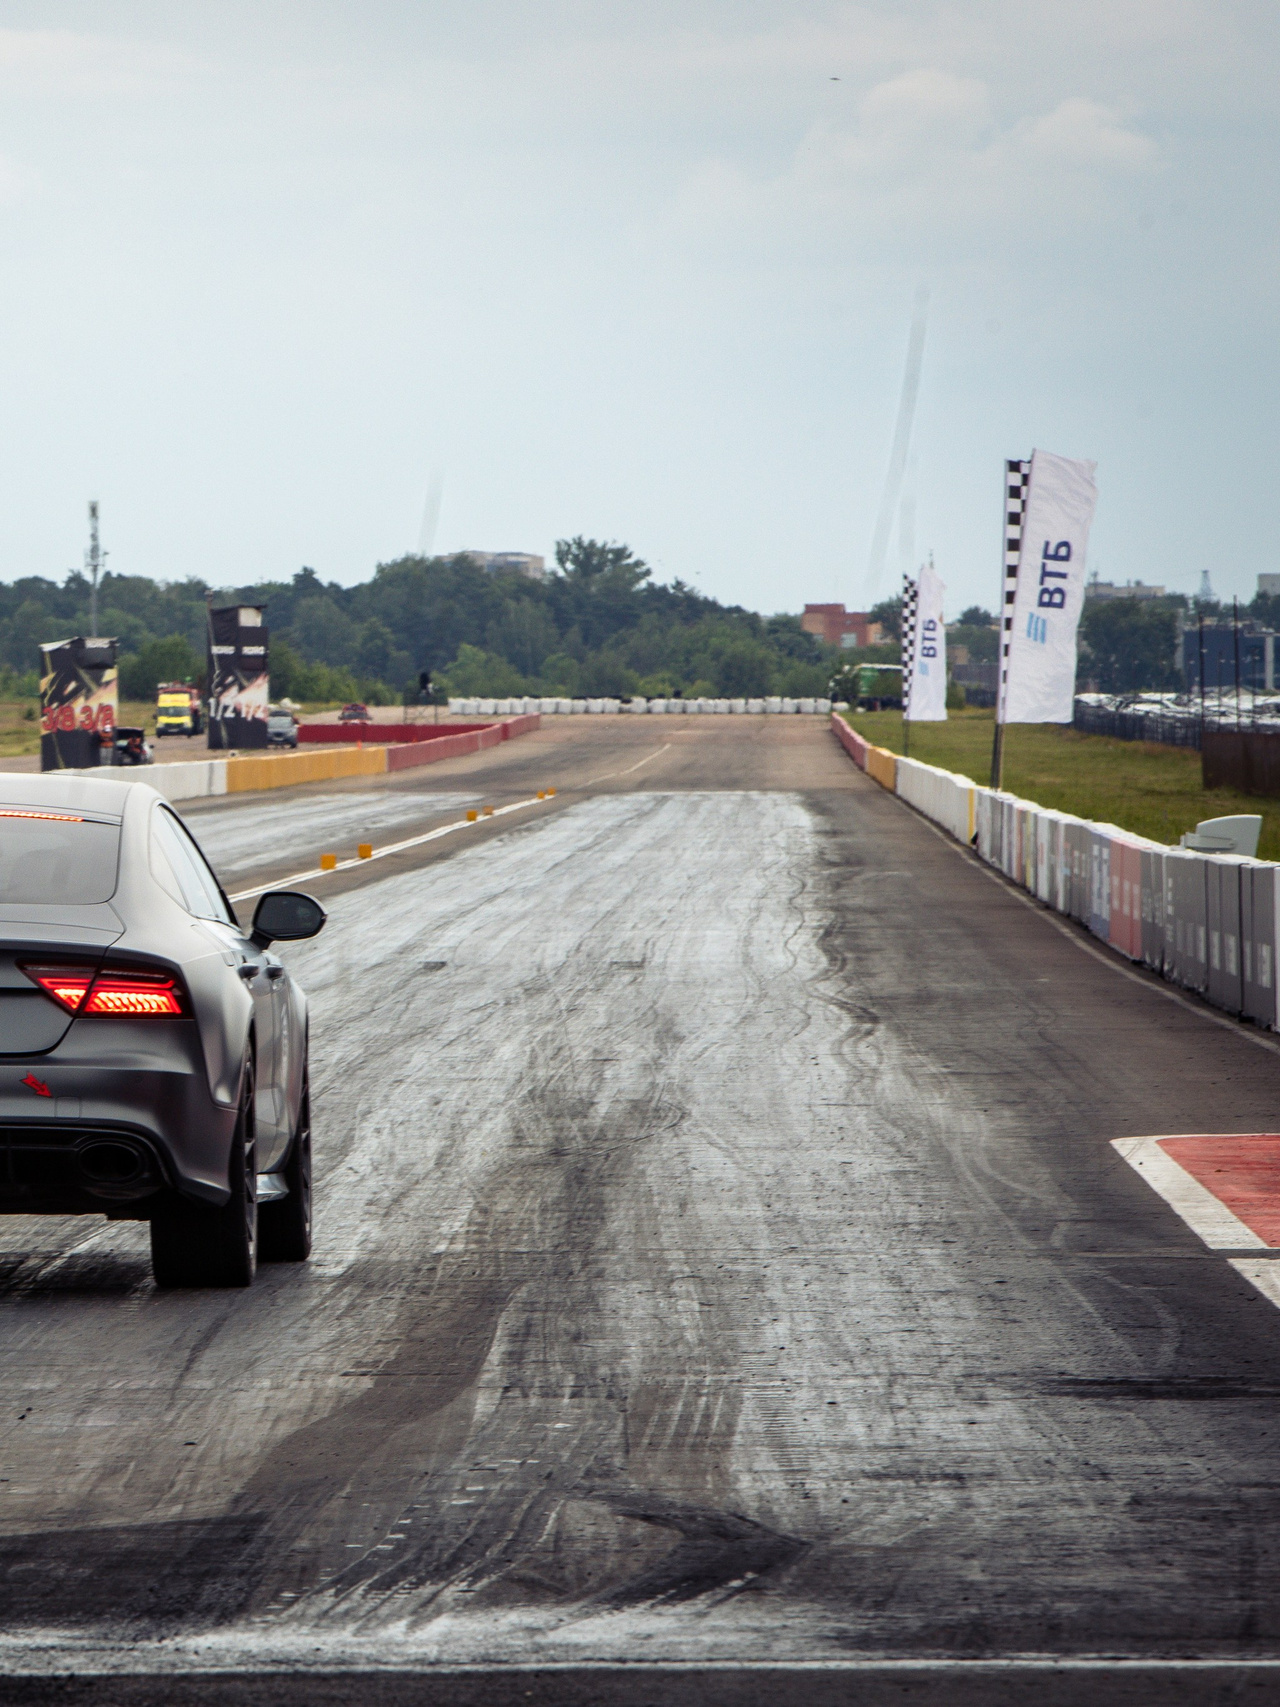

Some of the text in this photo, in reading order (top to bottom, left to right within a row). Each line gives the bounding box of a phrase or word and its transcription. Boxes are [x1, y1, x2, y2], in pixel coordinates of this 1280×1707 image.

[1037, 540, 1072, 609] ВТБ
[921, 618, 938, 658] ВТБ
[42, 704, 75, 733] 3/8
[80, 703, 114, 733] 3/8
[208, 698, 236, 720] 1/2
